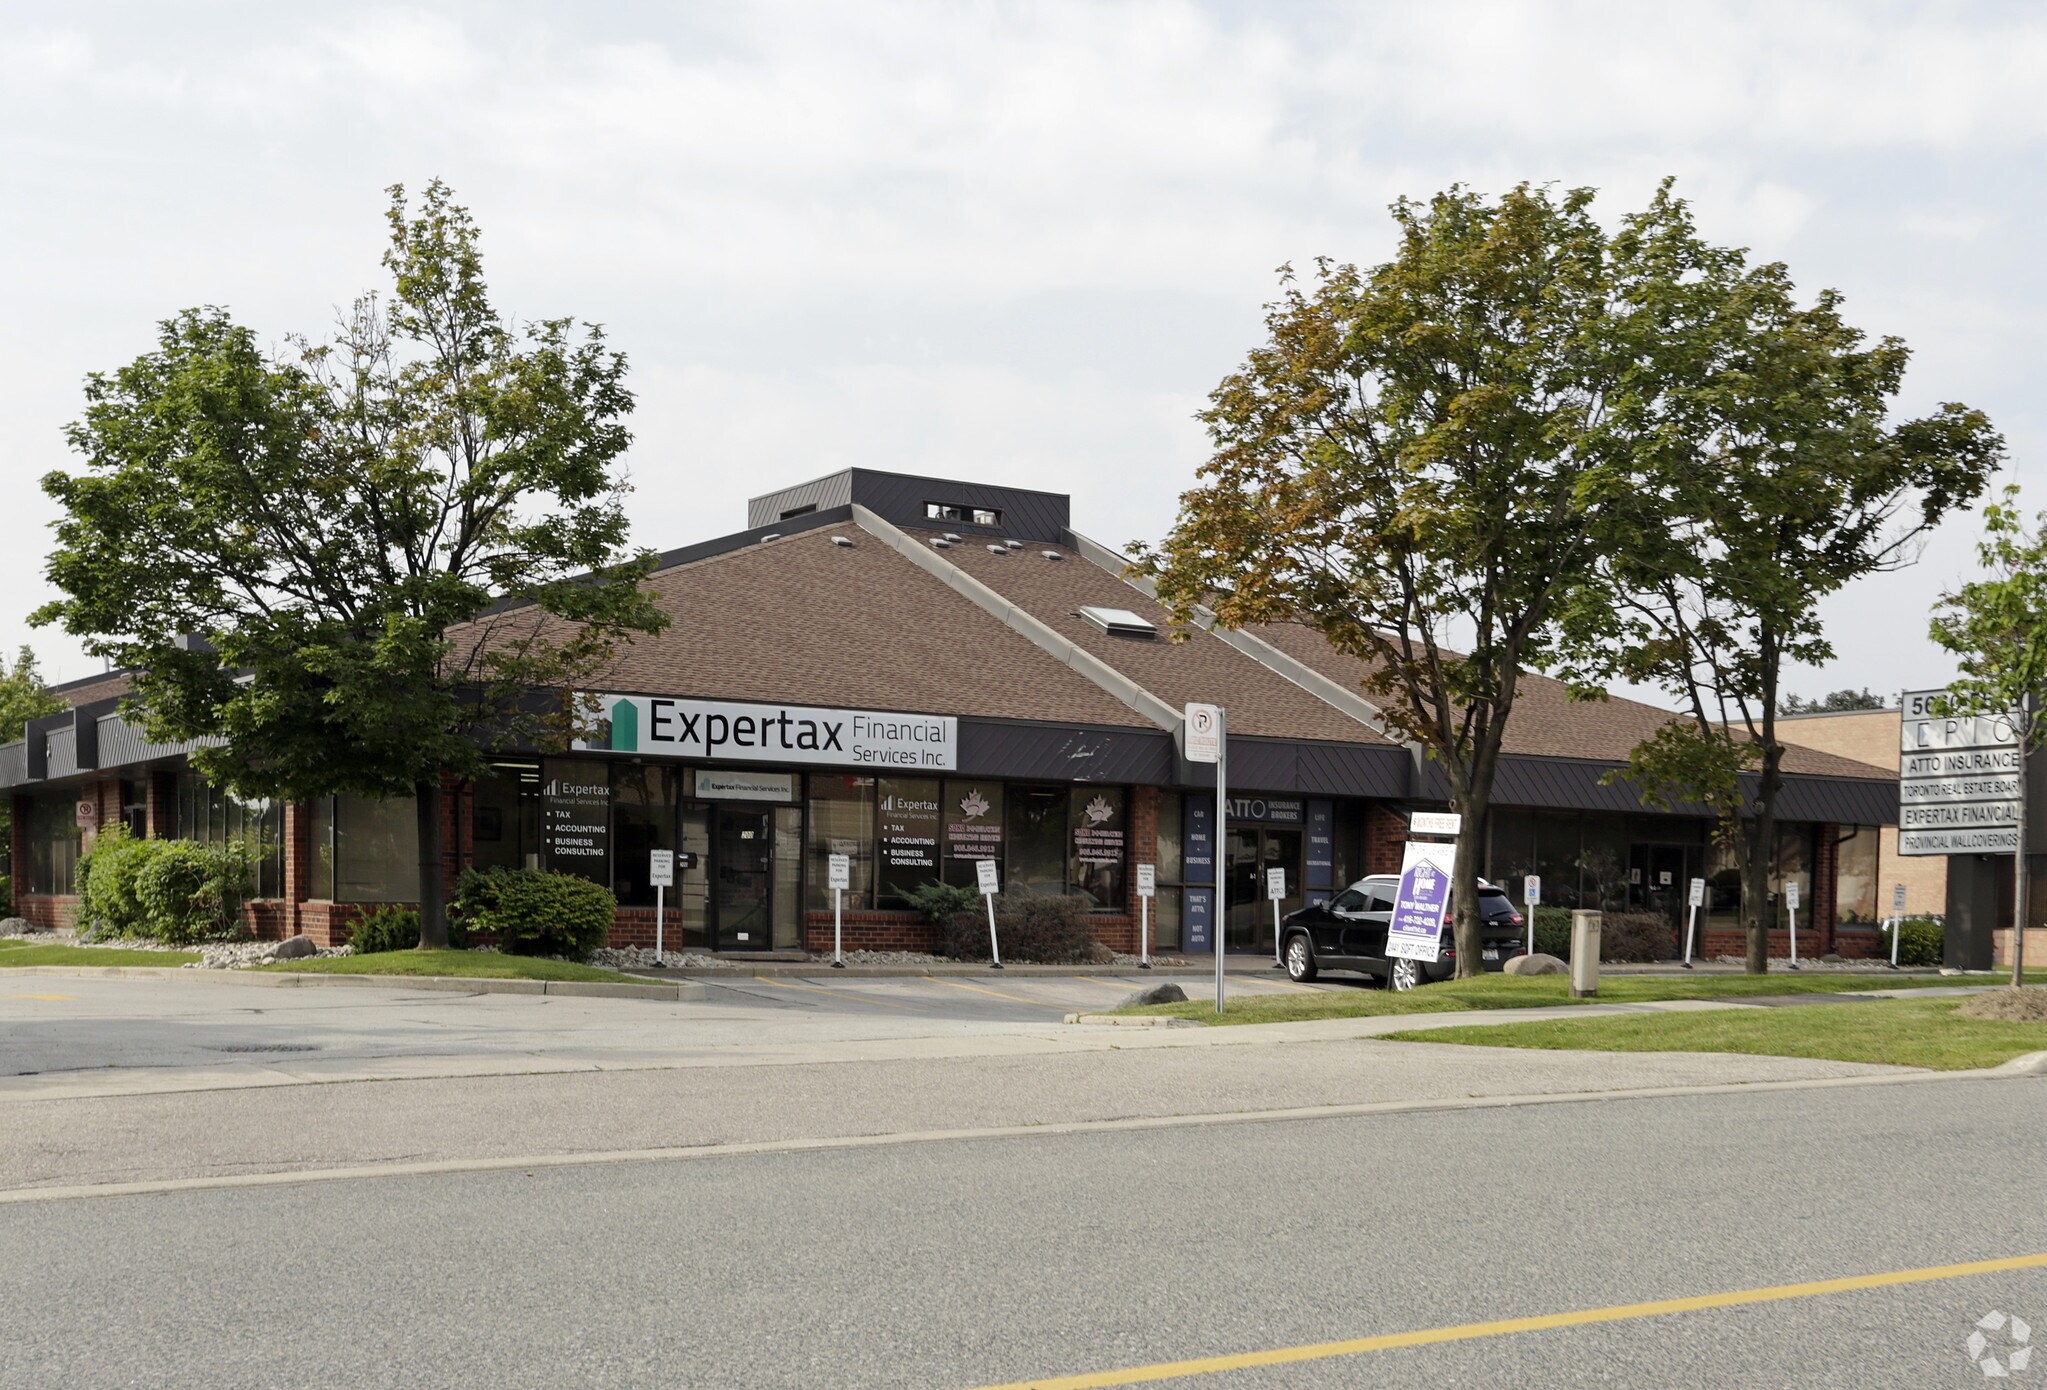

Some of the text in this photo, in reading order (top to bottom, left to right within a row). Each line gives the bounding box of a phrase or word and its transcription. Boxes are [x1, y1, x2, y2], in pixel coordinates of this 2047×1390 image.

[650, 700, 843, 757] Expertax
[852, 716, 947, 743] Financial
[852, 745, 947, 767] Services Inc.
[1910, 753, 2020, 773] ATTO INSURANCE
[562, 782, 610, 797] Expertax
[1903, 778, 2019, 799] TORONTO REAL ESTATE BOAR
[896, 797, 939, 812] Expertax
[1268, 800, 1301, 811] INSURANCE
[555, 810, 571, 819] TAX
[1194, 810, 1205, 818] CAR
[1270, 810, 1298, 821] BROKERS
[1315, 814, 1325, 822] LIFE
[1906, 805, 2019, 824] EXPERTAX FINANCIAL
[554, 824, 606, 834] ACCOUNTING
[891, 824, 905, 833] TAX
[554, 837, 593, 848] BUSINESS
[890, 836, 935, 846] ACCOUNTING
[1191, 834, 1206, 842] HOME
[1311, 836, 1329, 844] TRAVEL
[1904, 832, 2018, 849] PROVINCIAL WALLCOVERINGS
[554, 847, 604, 857] CONSULTING
[890, 849, 925, 858] BUSINESS
[890, 857, 934, 868] CONSULTING
[1186, 857, 1211, 865] BUSINESS
[1412, 878, 1436, 896] HOME
[1189, 895, 1207, 903] THAT'S
[1192, 925, 1203, 933] NOT
[1191, 935, 1205, 943] AUTO
[1415, 945, 1436, 958] OFFICE
